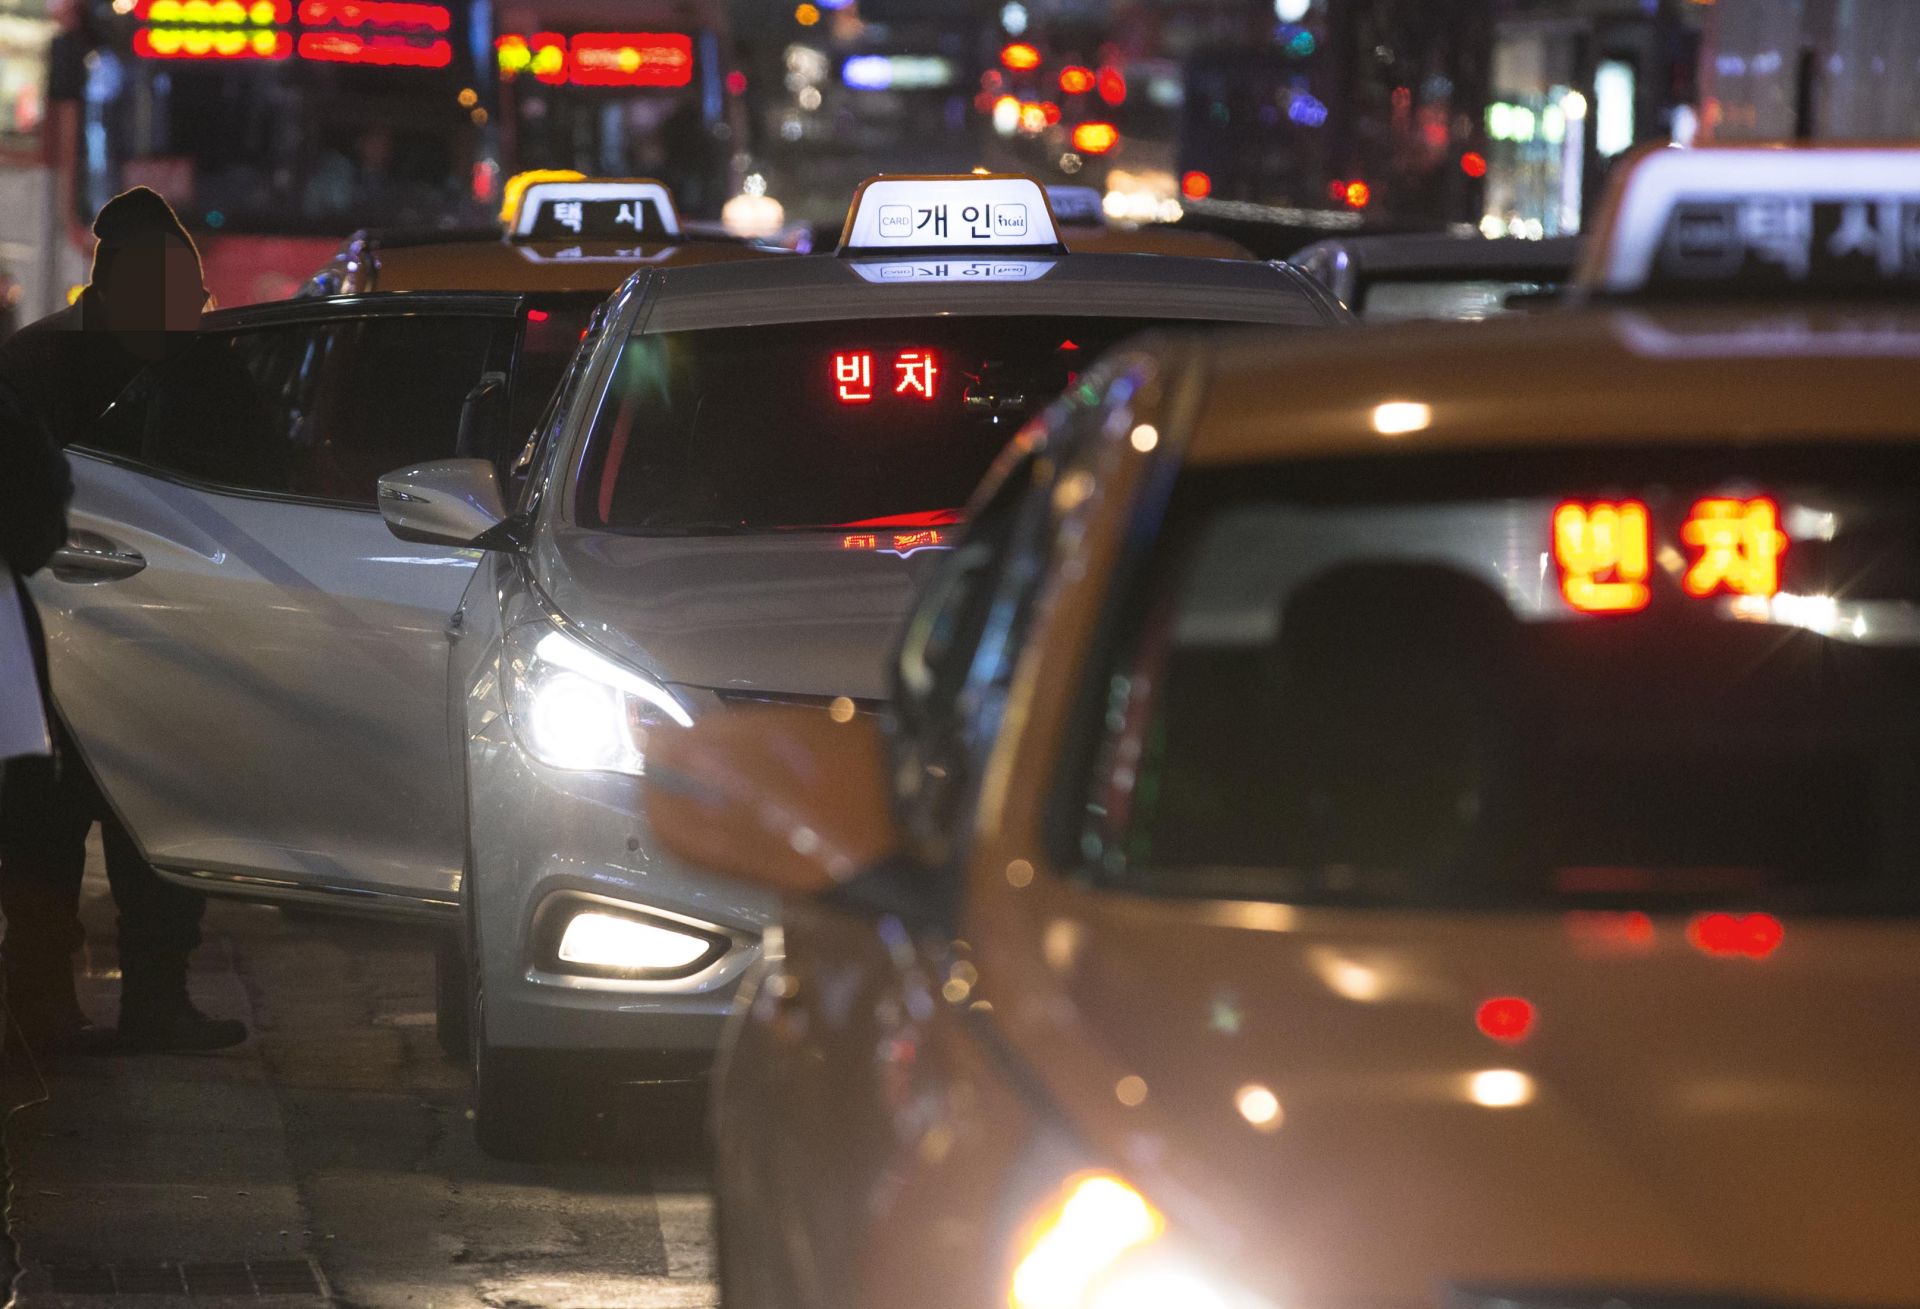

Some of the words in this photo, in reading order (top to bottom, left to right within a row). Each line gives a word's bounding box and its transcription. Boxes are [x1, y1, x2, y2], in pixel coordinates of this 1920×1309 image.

[554, 201, 643, 233] 택시
[882, 216, 909, 226] CARD
[917, 204, 990, 238] 개인
[835, 353, 937, 400] 빈차
